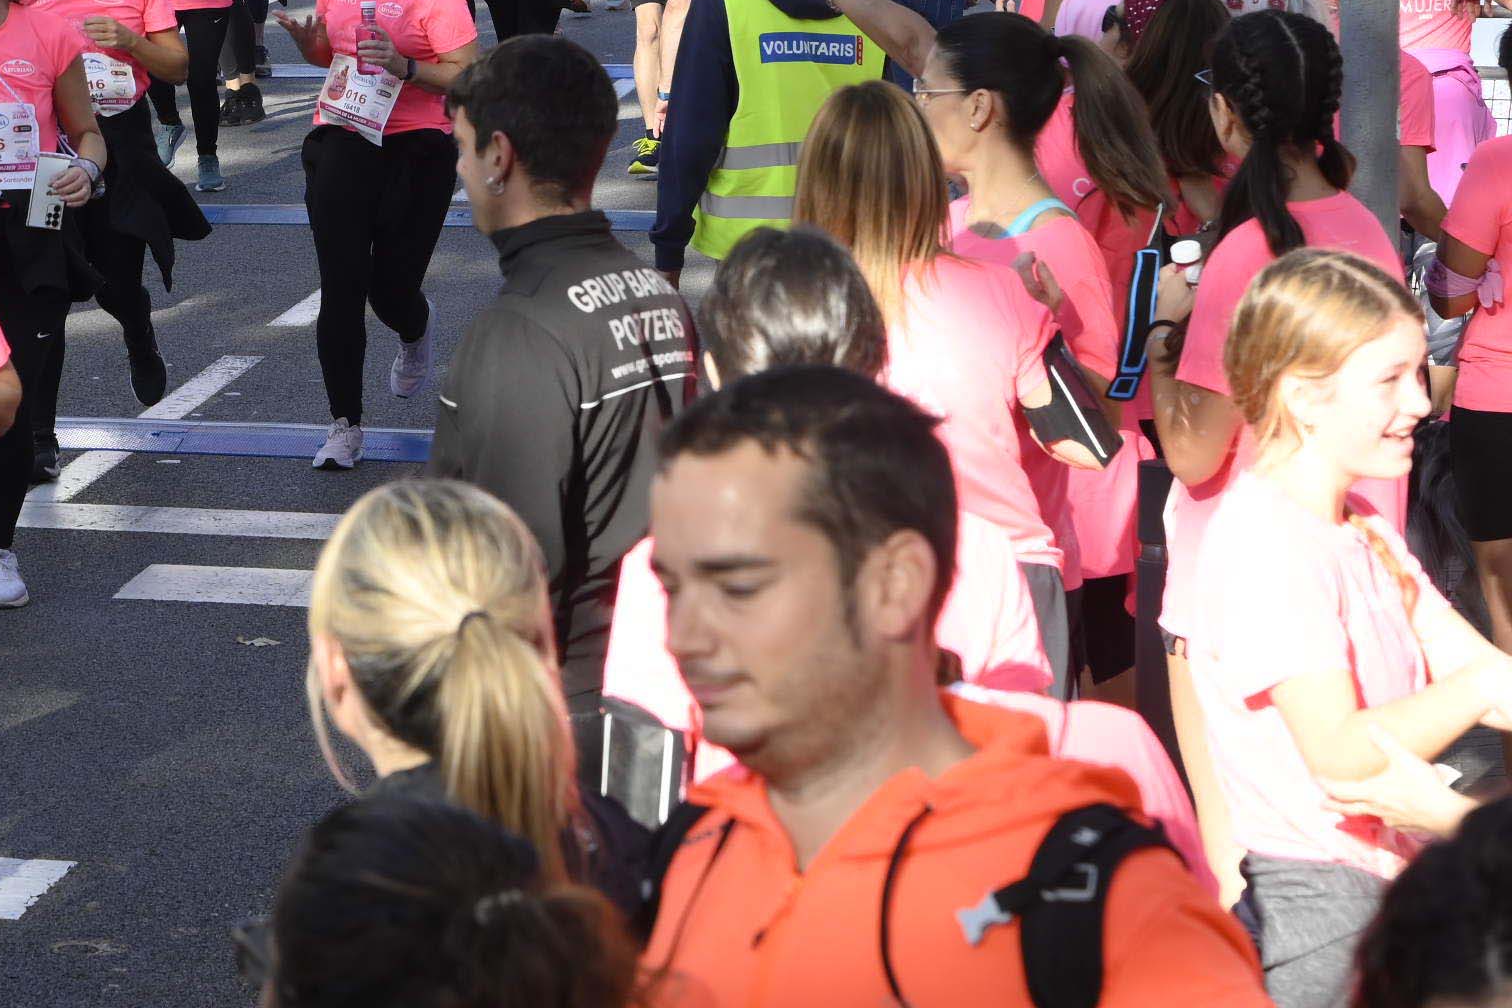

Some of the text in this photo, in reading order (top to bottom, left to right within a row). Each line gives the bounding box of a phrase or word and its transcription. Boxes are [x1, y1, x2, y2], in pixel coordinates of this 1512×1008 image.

[762, 40, 854, 58] VOLUNTARIS
[88, 79, 105, 91] 16
[345, 89, 367, 105] 016
[568, 272, 627, 313] GRUP
[608, 308, 685, 350] POTERS
